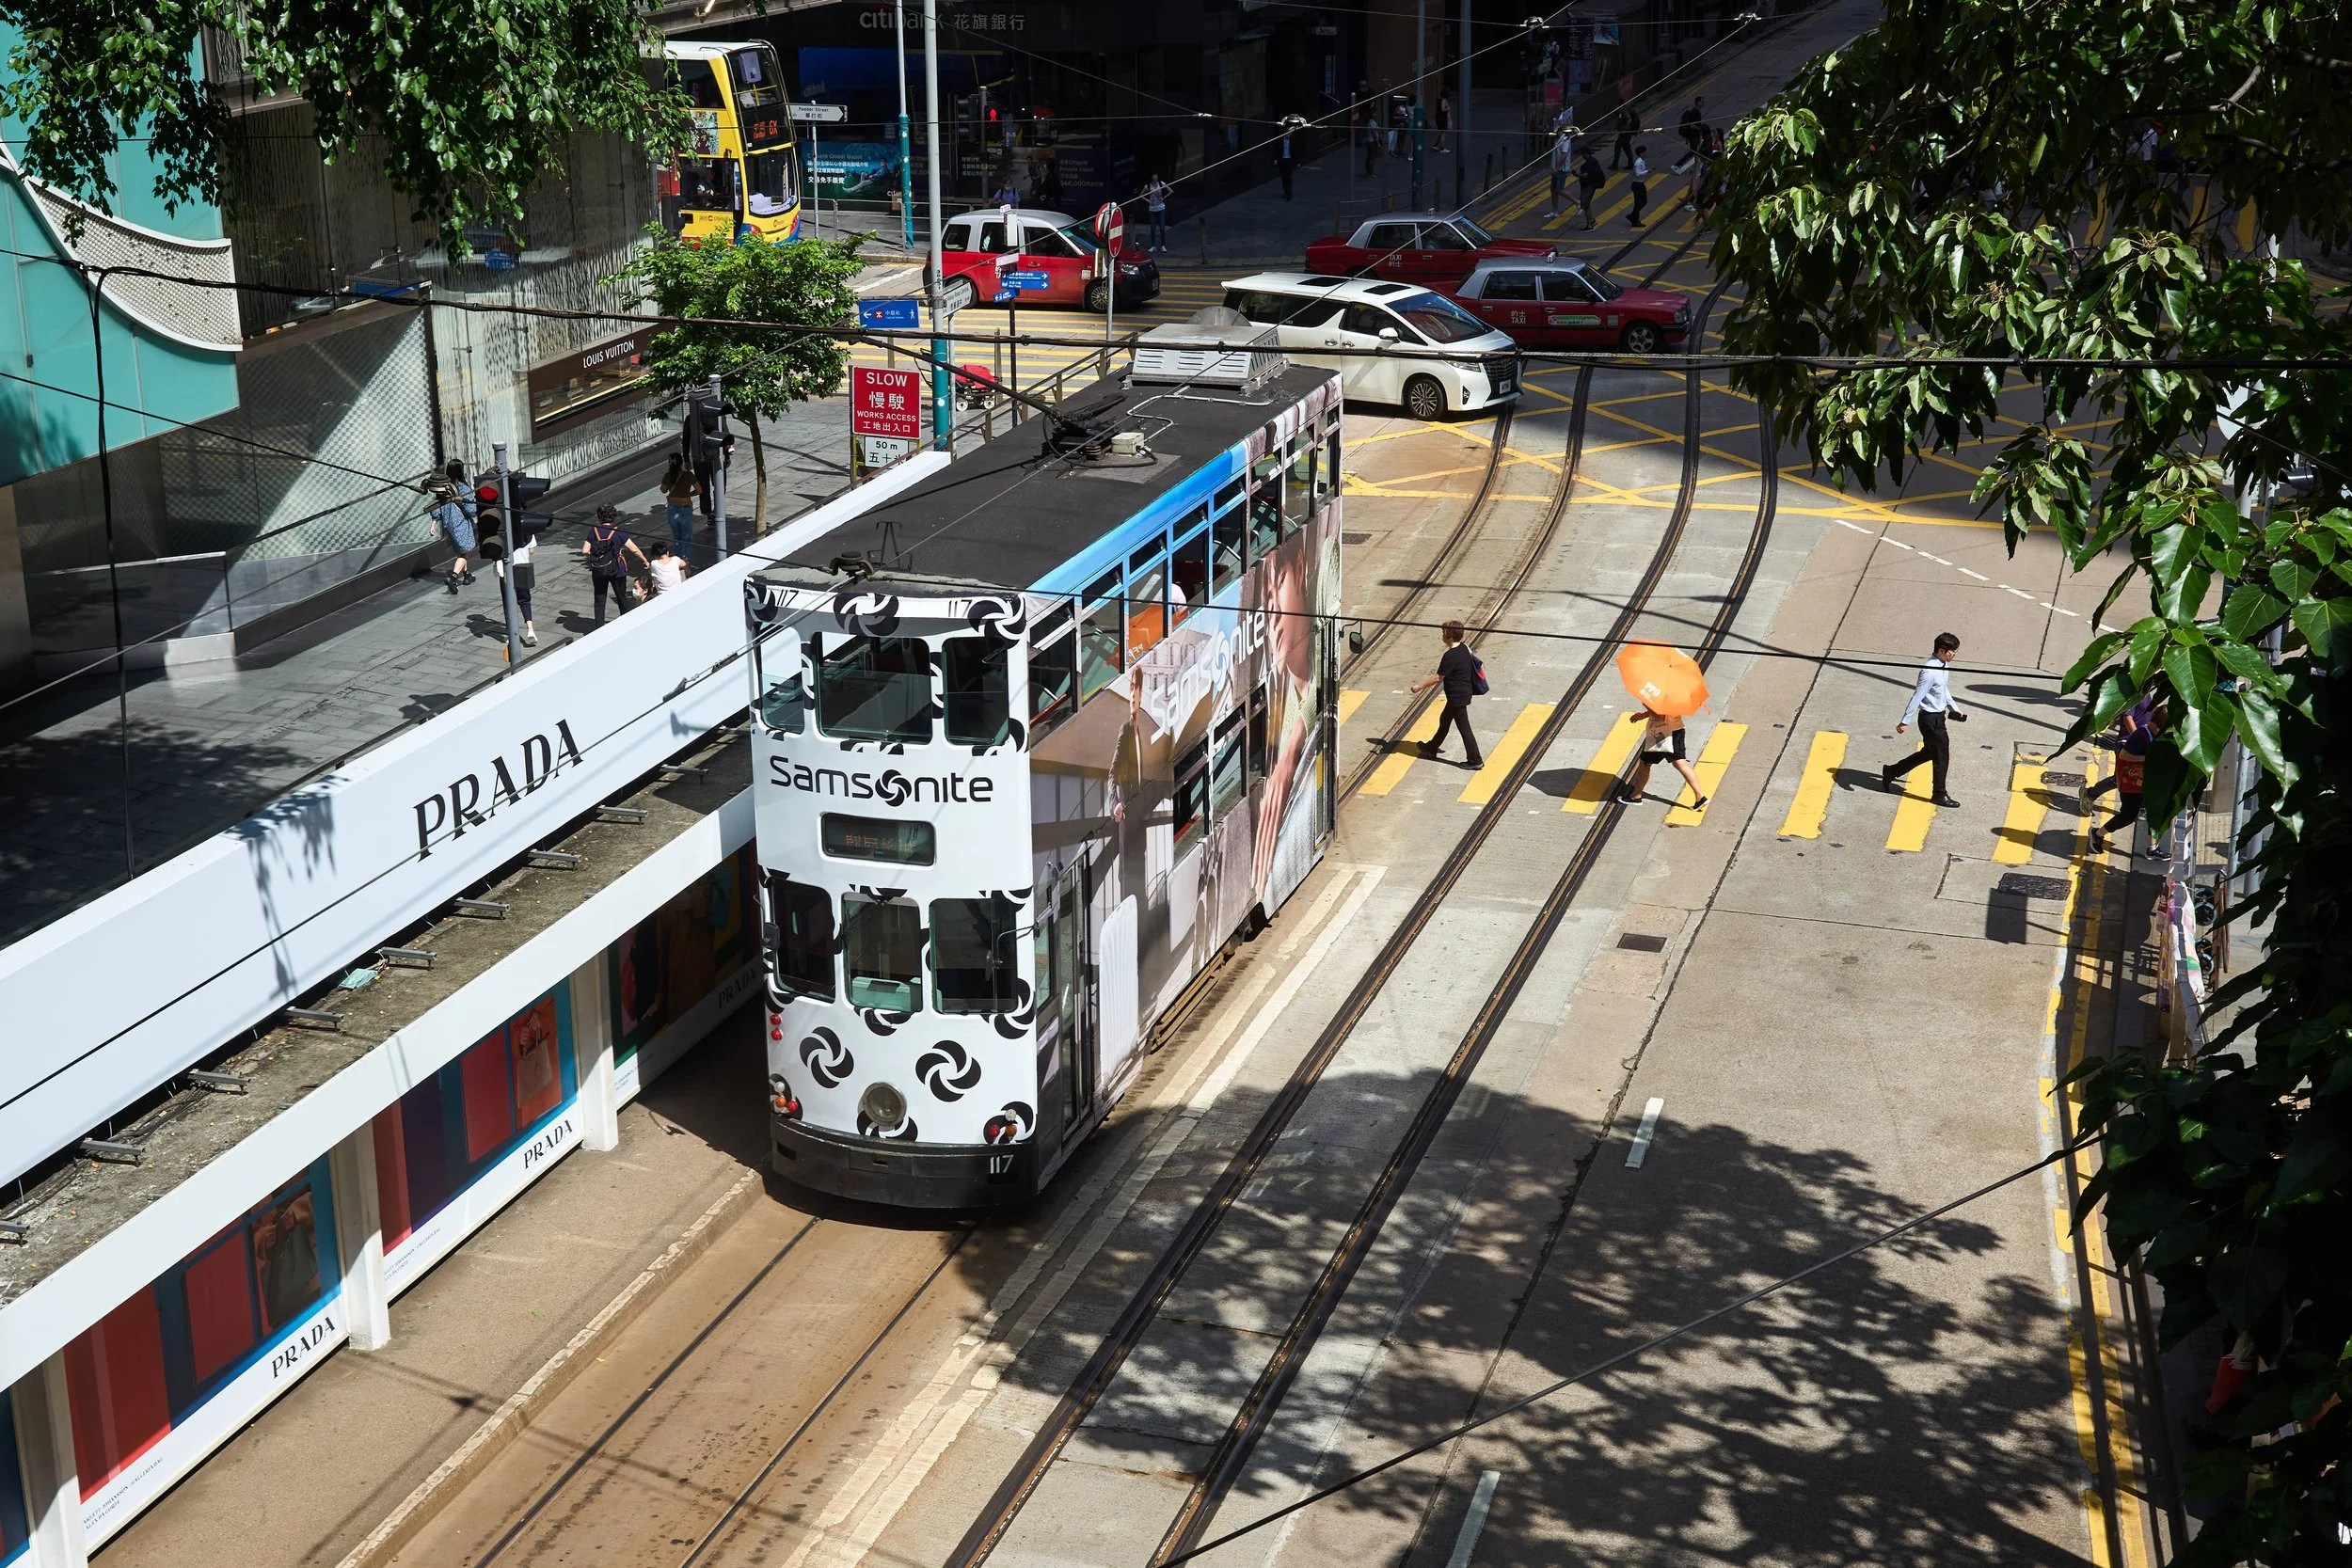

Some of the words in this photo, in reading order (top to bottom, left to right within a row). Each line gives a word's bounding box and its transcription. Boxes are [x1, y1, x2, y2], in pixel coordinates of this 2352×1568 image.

[954, 13, 1026, 31] 花旗銀行
[769, 119, 778, 135] 6X
[1511, 316, 1526, 325] TAXI
[583, 351, 604, 369] LOUIS
[605, 339, 635, 359] VUITTON
[866, 372, 908, 387] SLOW
[868, 391, 905, 411] 慢駛
[856, 410, 884, 420] WORKS
[885, 413, 917, 422] ACCESS
[863, 420, 911, 433] 工地出入口
[875, 440, 887, 450] 50
[777, 589, 799, 607] 117
[947, 599, 972, 619] 117
[1150, 604, 1267, 746] Samsonite
[412, 719, 584, 863] PRADA
[770, 755, 993, 807] Samsonite
[718, 968, 757, 1009] PRADA
[523, 1119, 573, 1170] PRADA
[989, 1154, 1015, 1175] 117
[271, 1316, 337, 1380] PRADA
